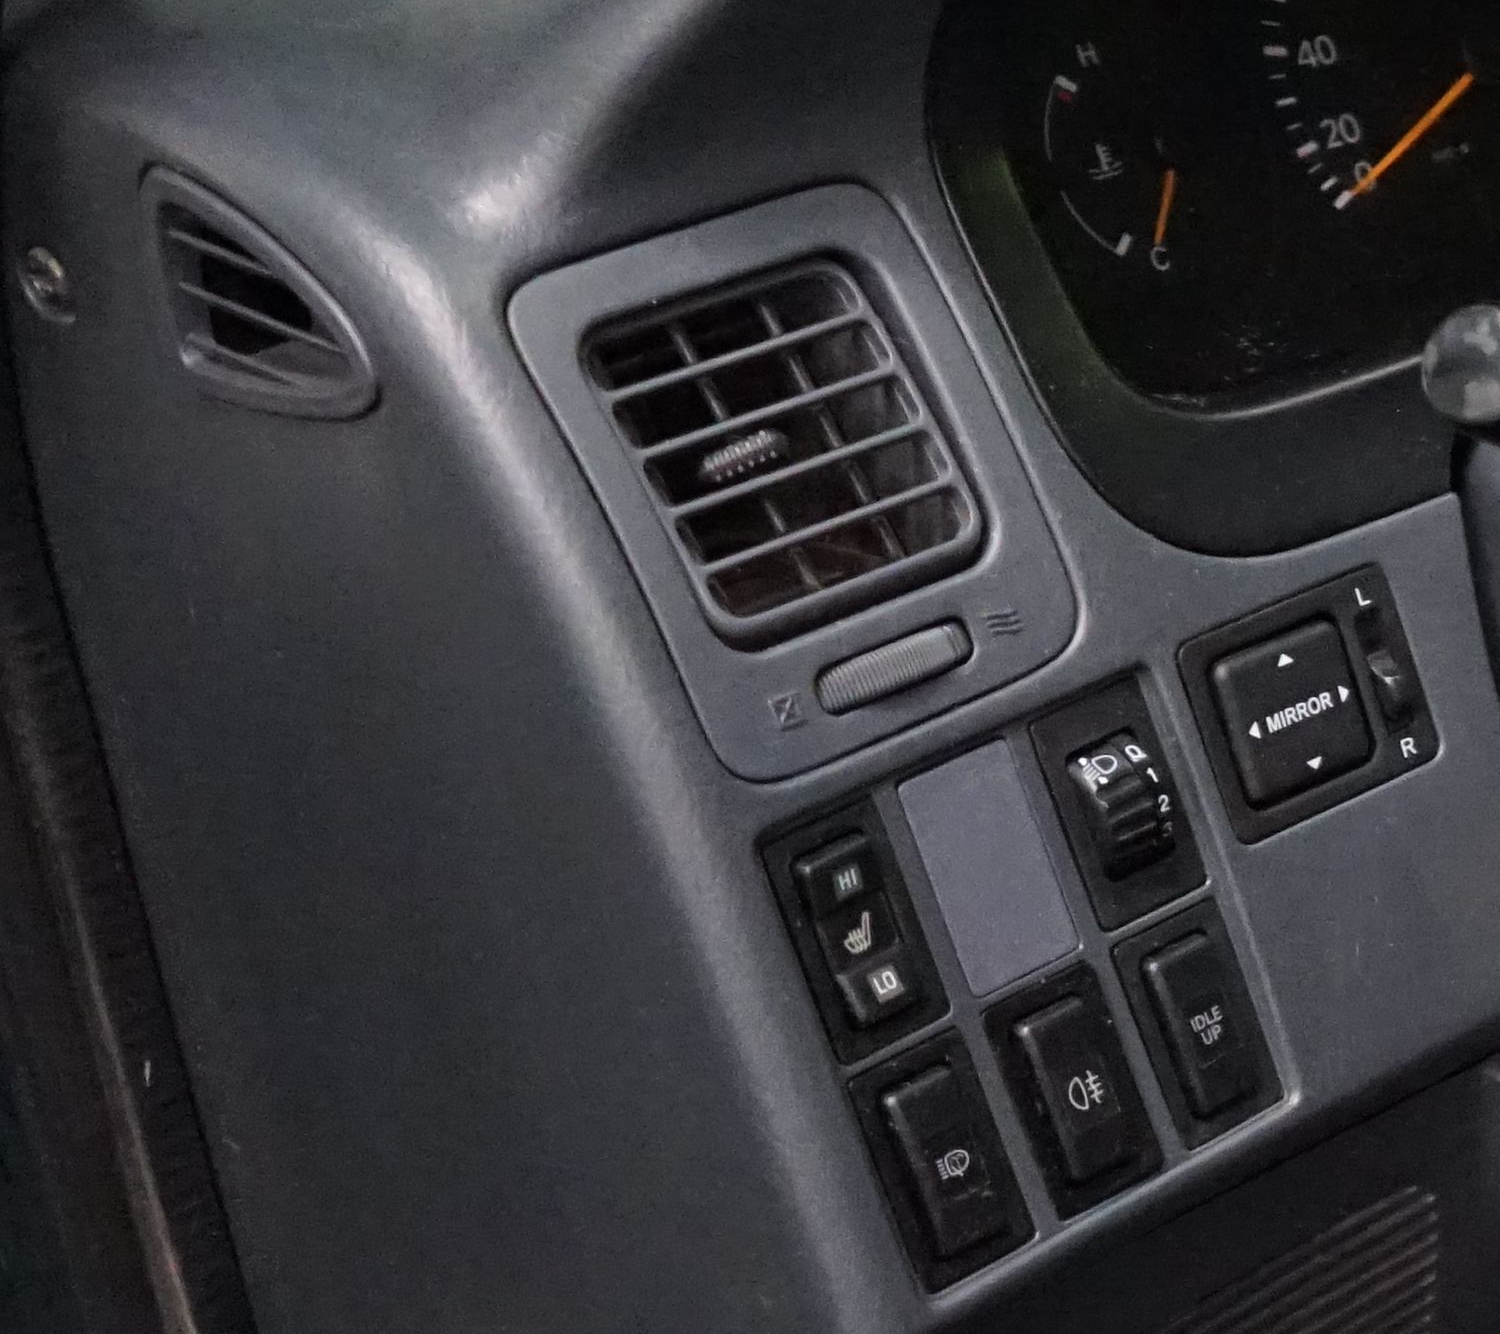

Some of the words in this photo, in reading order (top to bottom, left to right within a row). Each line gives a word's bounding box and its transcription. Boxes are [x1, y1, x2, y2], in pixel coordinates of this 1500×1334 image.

[1075, 41, 1100, 68] H
[1298, 34, 1338, 67] 40
[1319, 112, 1362, 151] 20
[1353, 160, 1378, 190] 0
[1150, 246, 1171, 272] C
[1353, 587, 1372, 607] L
[1265, 691, 1335, 734] MIRROR
[1399, 736, 1418, 759] R
[1146, 767, 1159, 783] 1
[1158, 794, 1170, 812] 2
[838, 868, 859, 892] HI
[873, 970, 898, 995] LO
[1189, 1005, 1223, 1034] IDLE
[1200, 1024, 1222, 1046] UP
